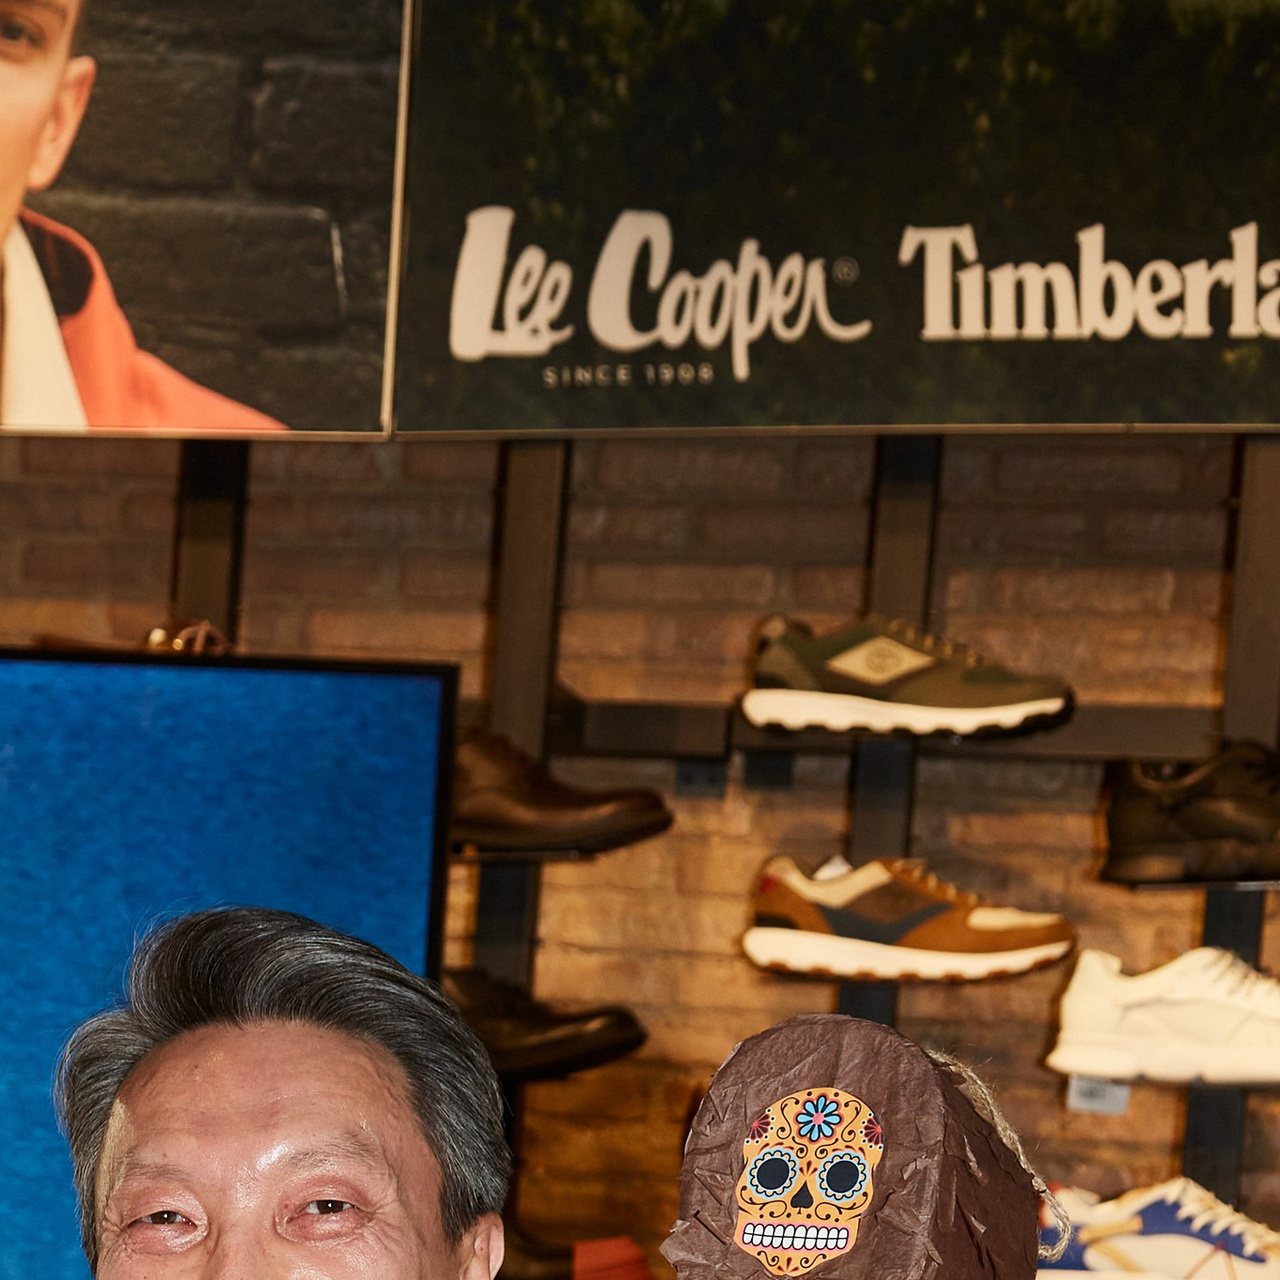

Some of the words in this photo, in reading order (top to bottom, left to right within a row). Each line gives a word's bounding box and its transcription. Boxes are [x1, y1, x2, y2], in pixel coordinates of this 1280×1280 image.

[449, 205, 574, 362] Lee
[586, 209, 873, 382] Cooper
[542, 365, 632, 388] SINCE
